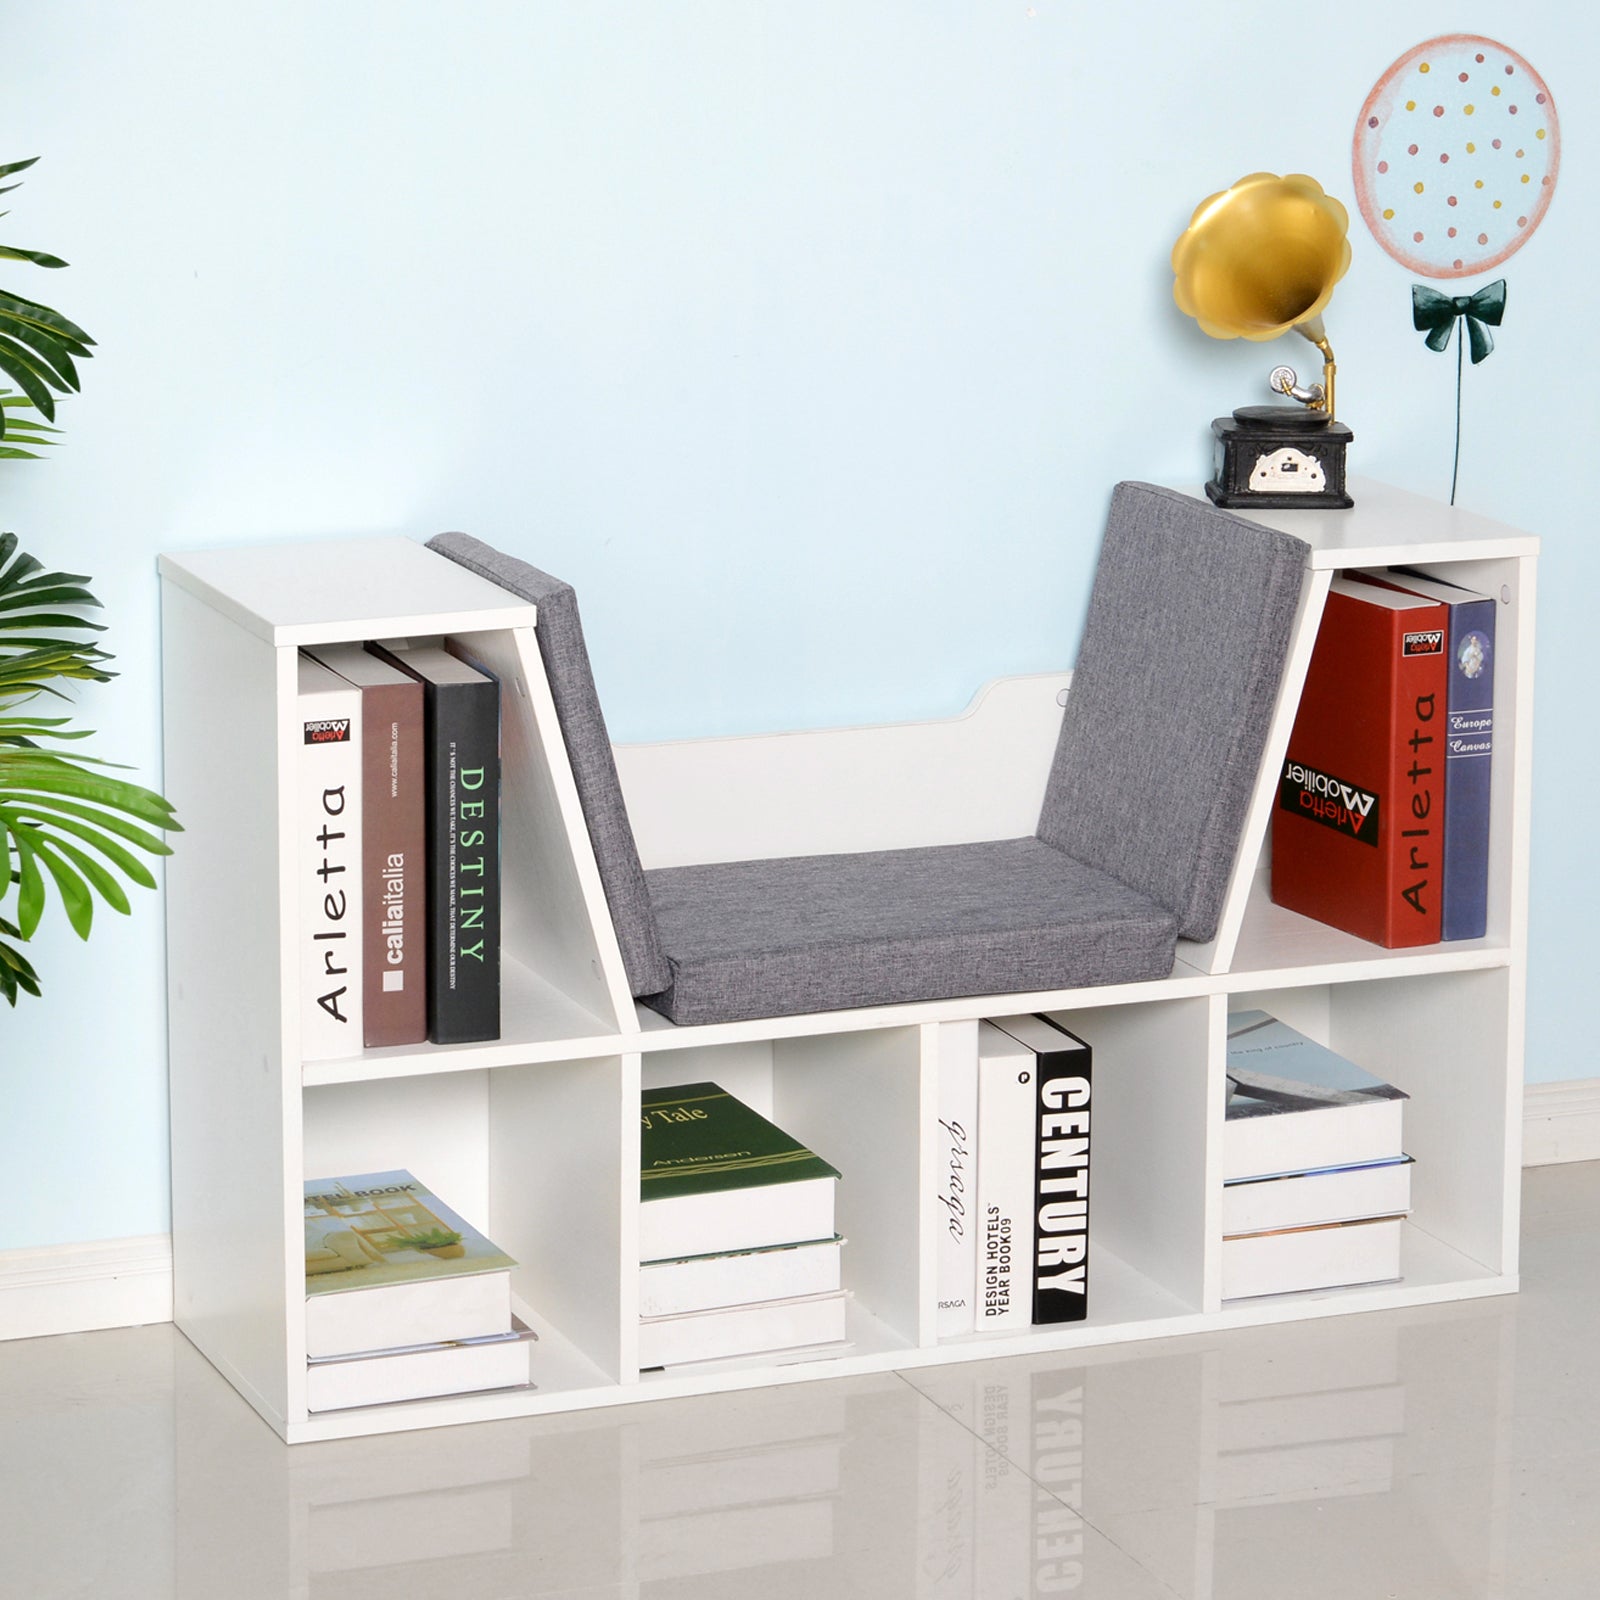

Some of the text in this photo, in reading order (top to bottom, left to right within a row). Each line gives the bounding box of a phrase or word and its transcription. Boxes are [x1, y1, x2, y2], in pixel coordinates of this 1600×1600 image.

[1450, 740, 1491, 752] Canvas
[1451, 716, 1492, 730] Europe
[389, 722, 398, 797] www.caliaitalia.com
[450, 807, 456, 816] WE
[1286, 763, 1375, 816] Mobilier
[1300, 790, 1365, 834] Arletta
[1401, 693, 1435, 915] Arletta
[450, 880, 456, 889] WE
[460, 766, 485, 962] DESTINY
[313, 785, 347, 1023] Arletta
[382, 853, 404, 964] caliaitalia
[651, 1107, 708, 1123] Tale
[353, 1184, 416, 1197] BOOK
[1038, 1076, 1091, 1295] CENTURY
[985, 1206, 1000, 1316] DESIGN HOTELS
[998, 1218, 1012, 1315] YEAR BOOK09
[938, 1299, 966, 1309] RSAGA
